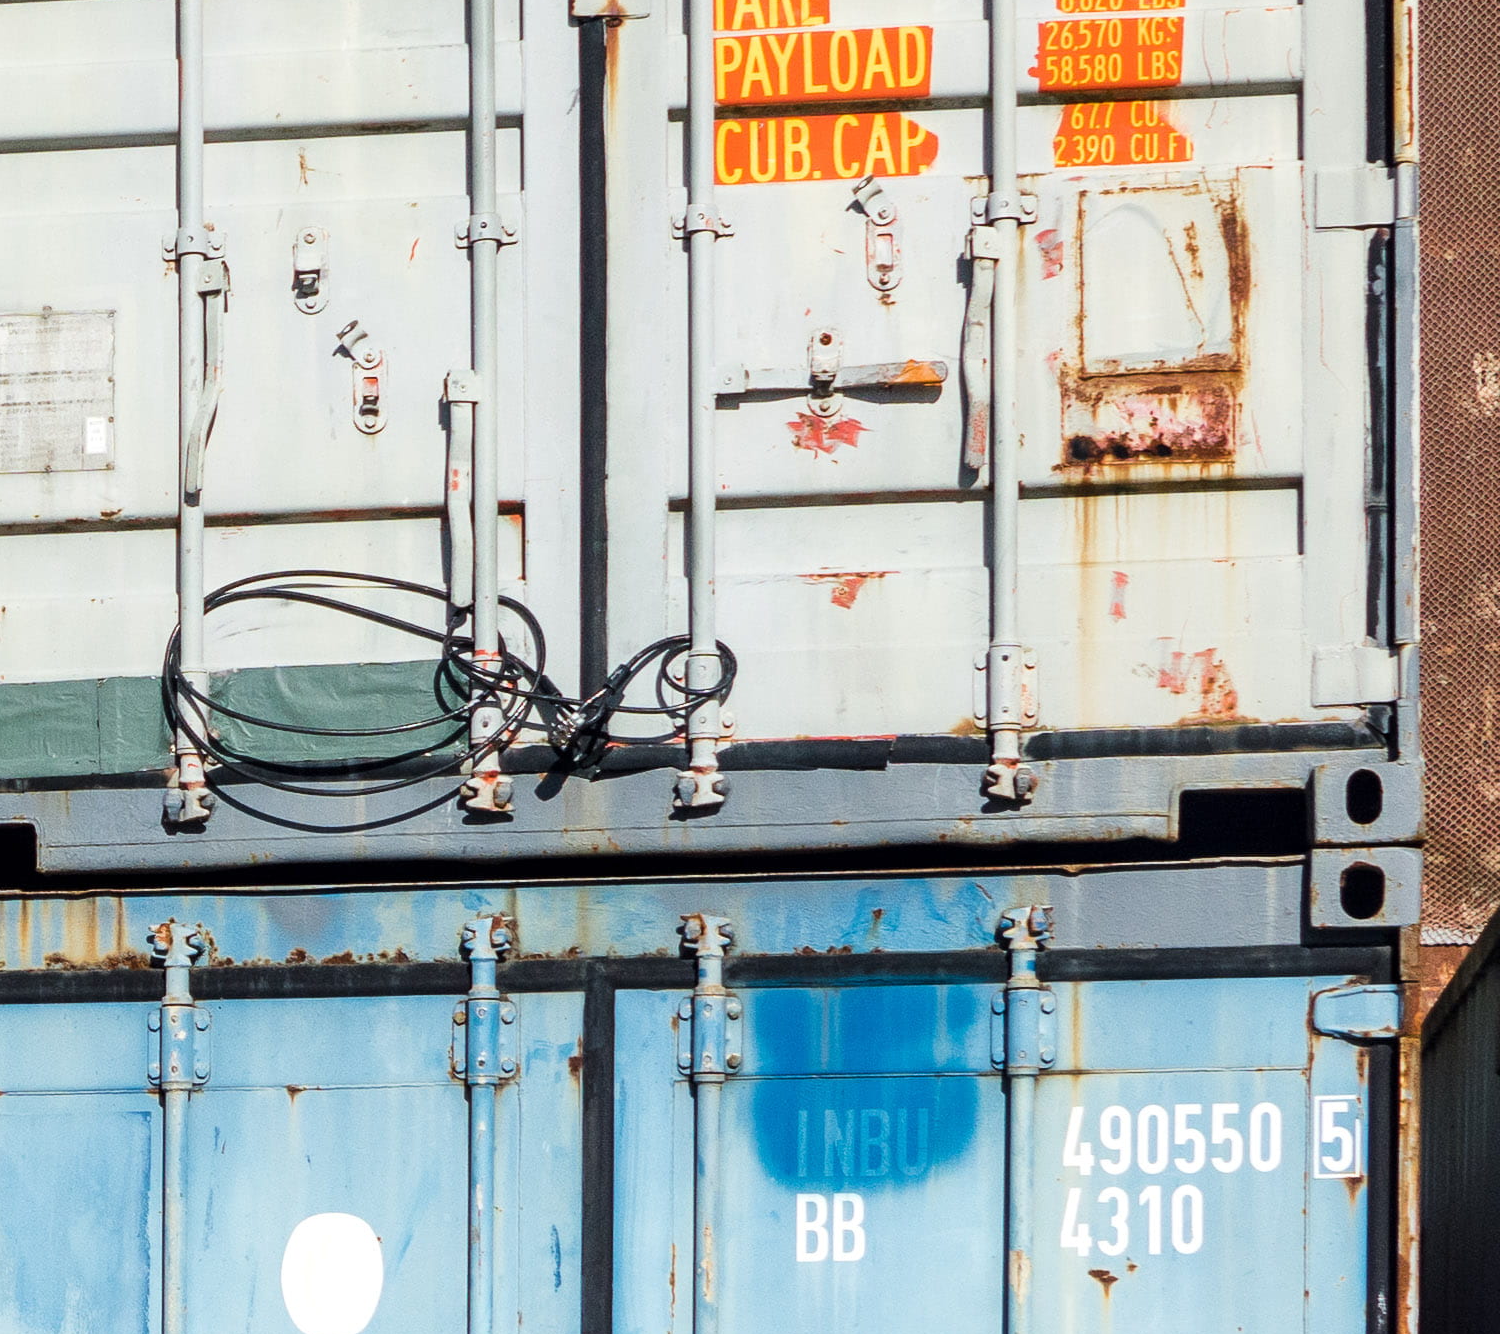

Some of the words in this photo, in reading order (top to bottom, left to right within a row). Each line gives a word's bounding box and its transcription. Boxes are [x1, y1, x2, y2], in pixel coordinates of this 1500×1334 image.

[1045, 18, 1123, 52] 26,570
[715, 26, 927, 101] PAYLOAD
[1045, 52, 1123, 86] 58,580
[1137, 50, 1180, 81] LBS
[1070, 102, 1115, 130] 67.7
[1062, 1102, 1282, 1177] 490550
[1321, 1100, 1356, 1173] 5
[795, 1192, 866, 1263] BB
[1060, 1184, 1203, 1257] 4310
